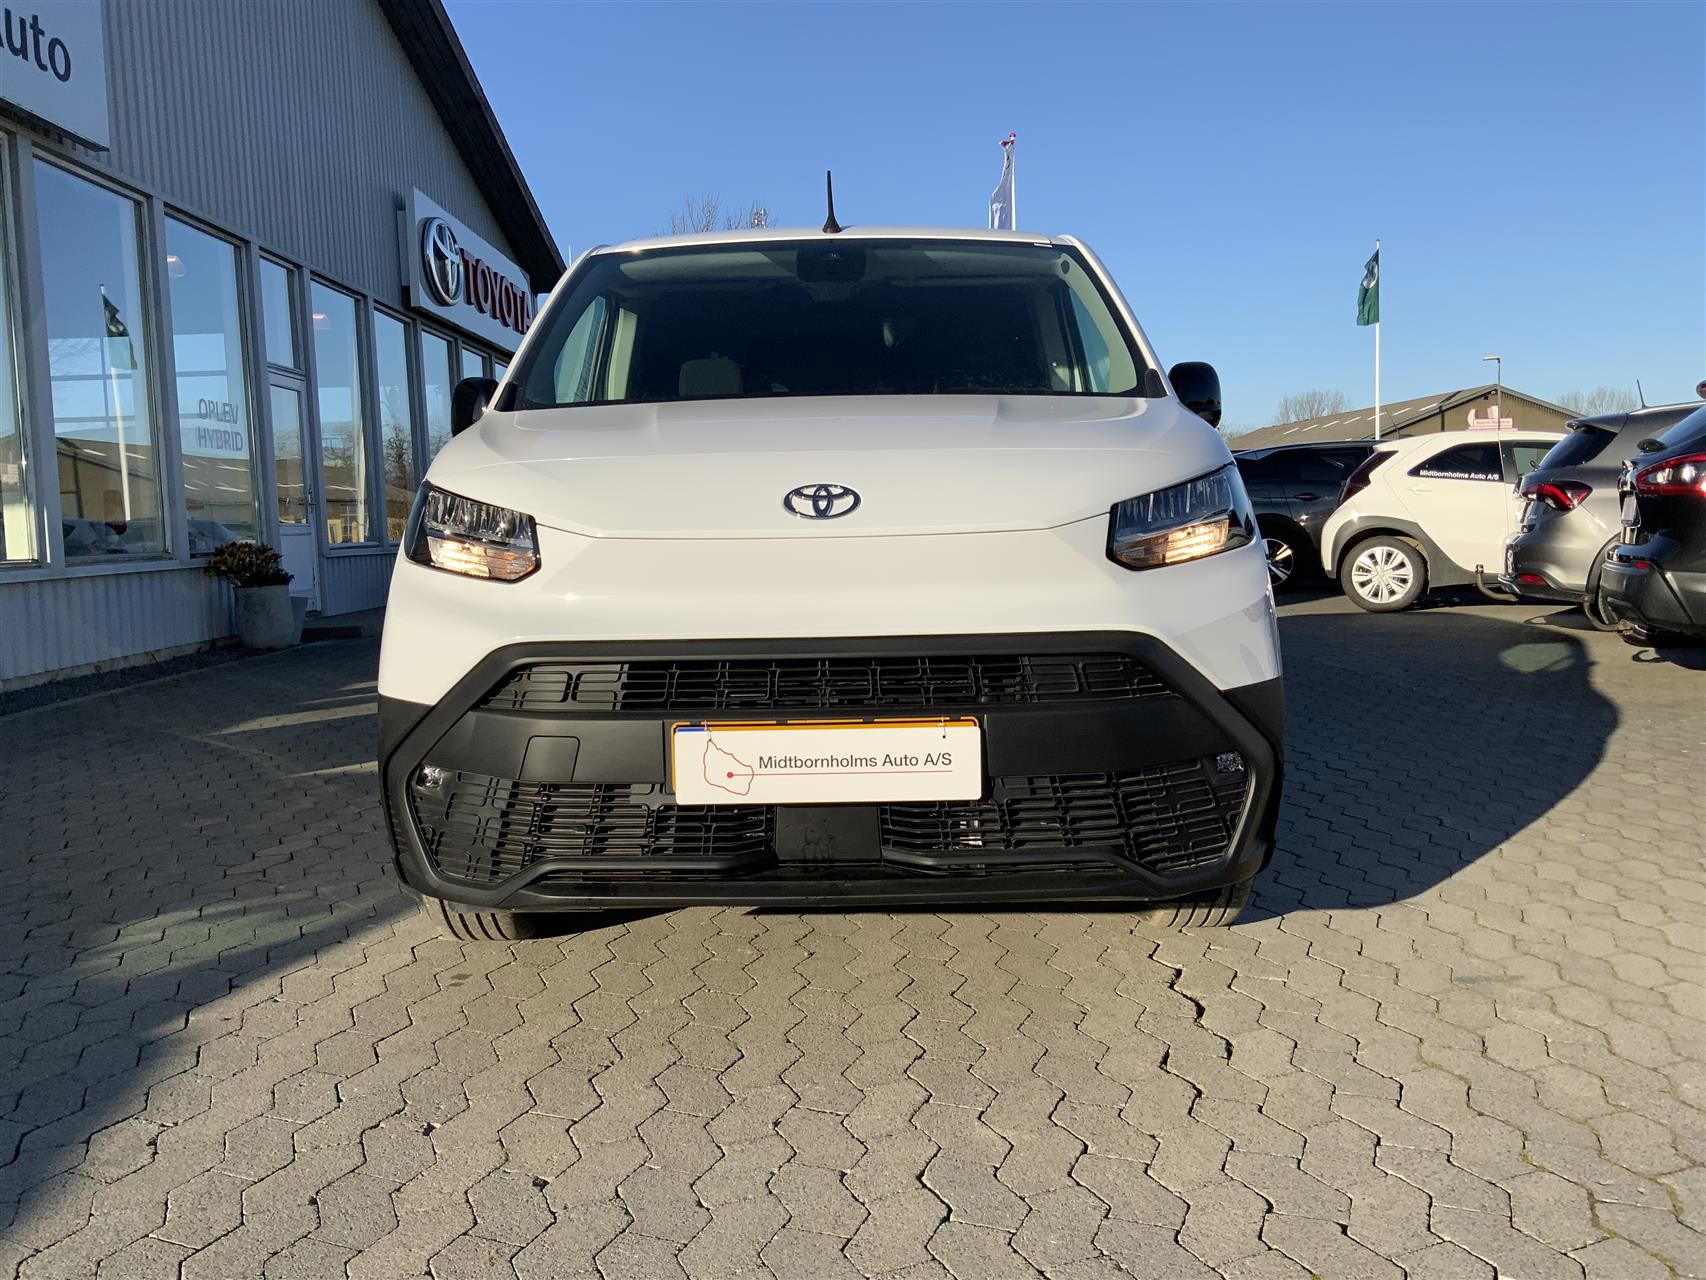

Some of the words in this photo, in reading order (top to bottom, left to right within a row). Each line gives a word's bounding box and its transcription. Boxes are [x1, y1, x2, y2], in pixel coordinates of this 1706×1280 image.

[0, 7, 71, 82] uto
[459, 247, 532, 335] TOYOTA
[198, 398, 239, 424] OPLEV
[197, 426, 244, 451] HYBRID
[1420, 470, 1469, 479] Midtbornholms
[759, 754, 878, 769] Midtbornholms
[882, 753, 919, 767] Auto
[924, 752, 952, 766] A/S
